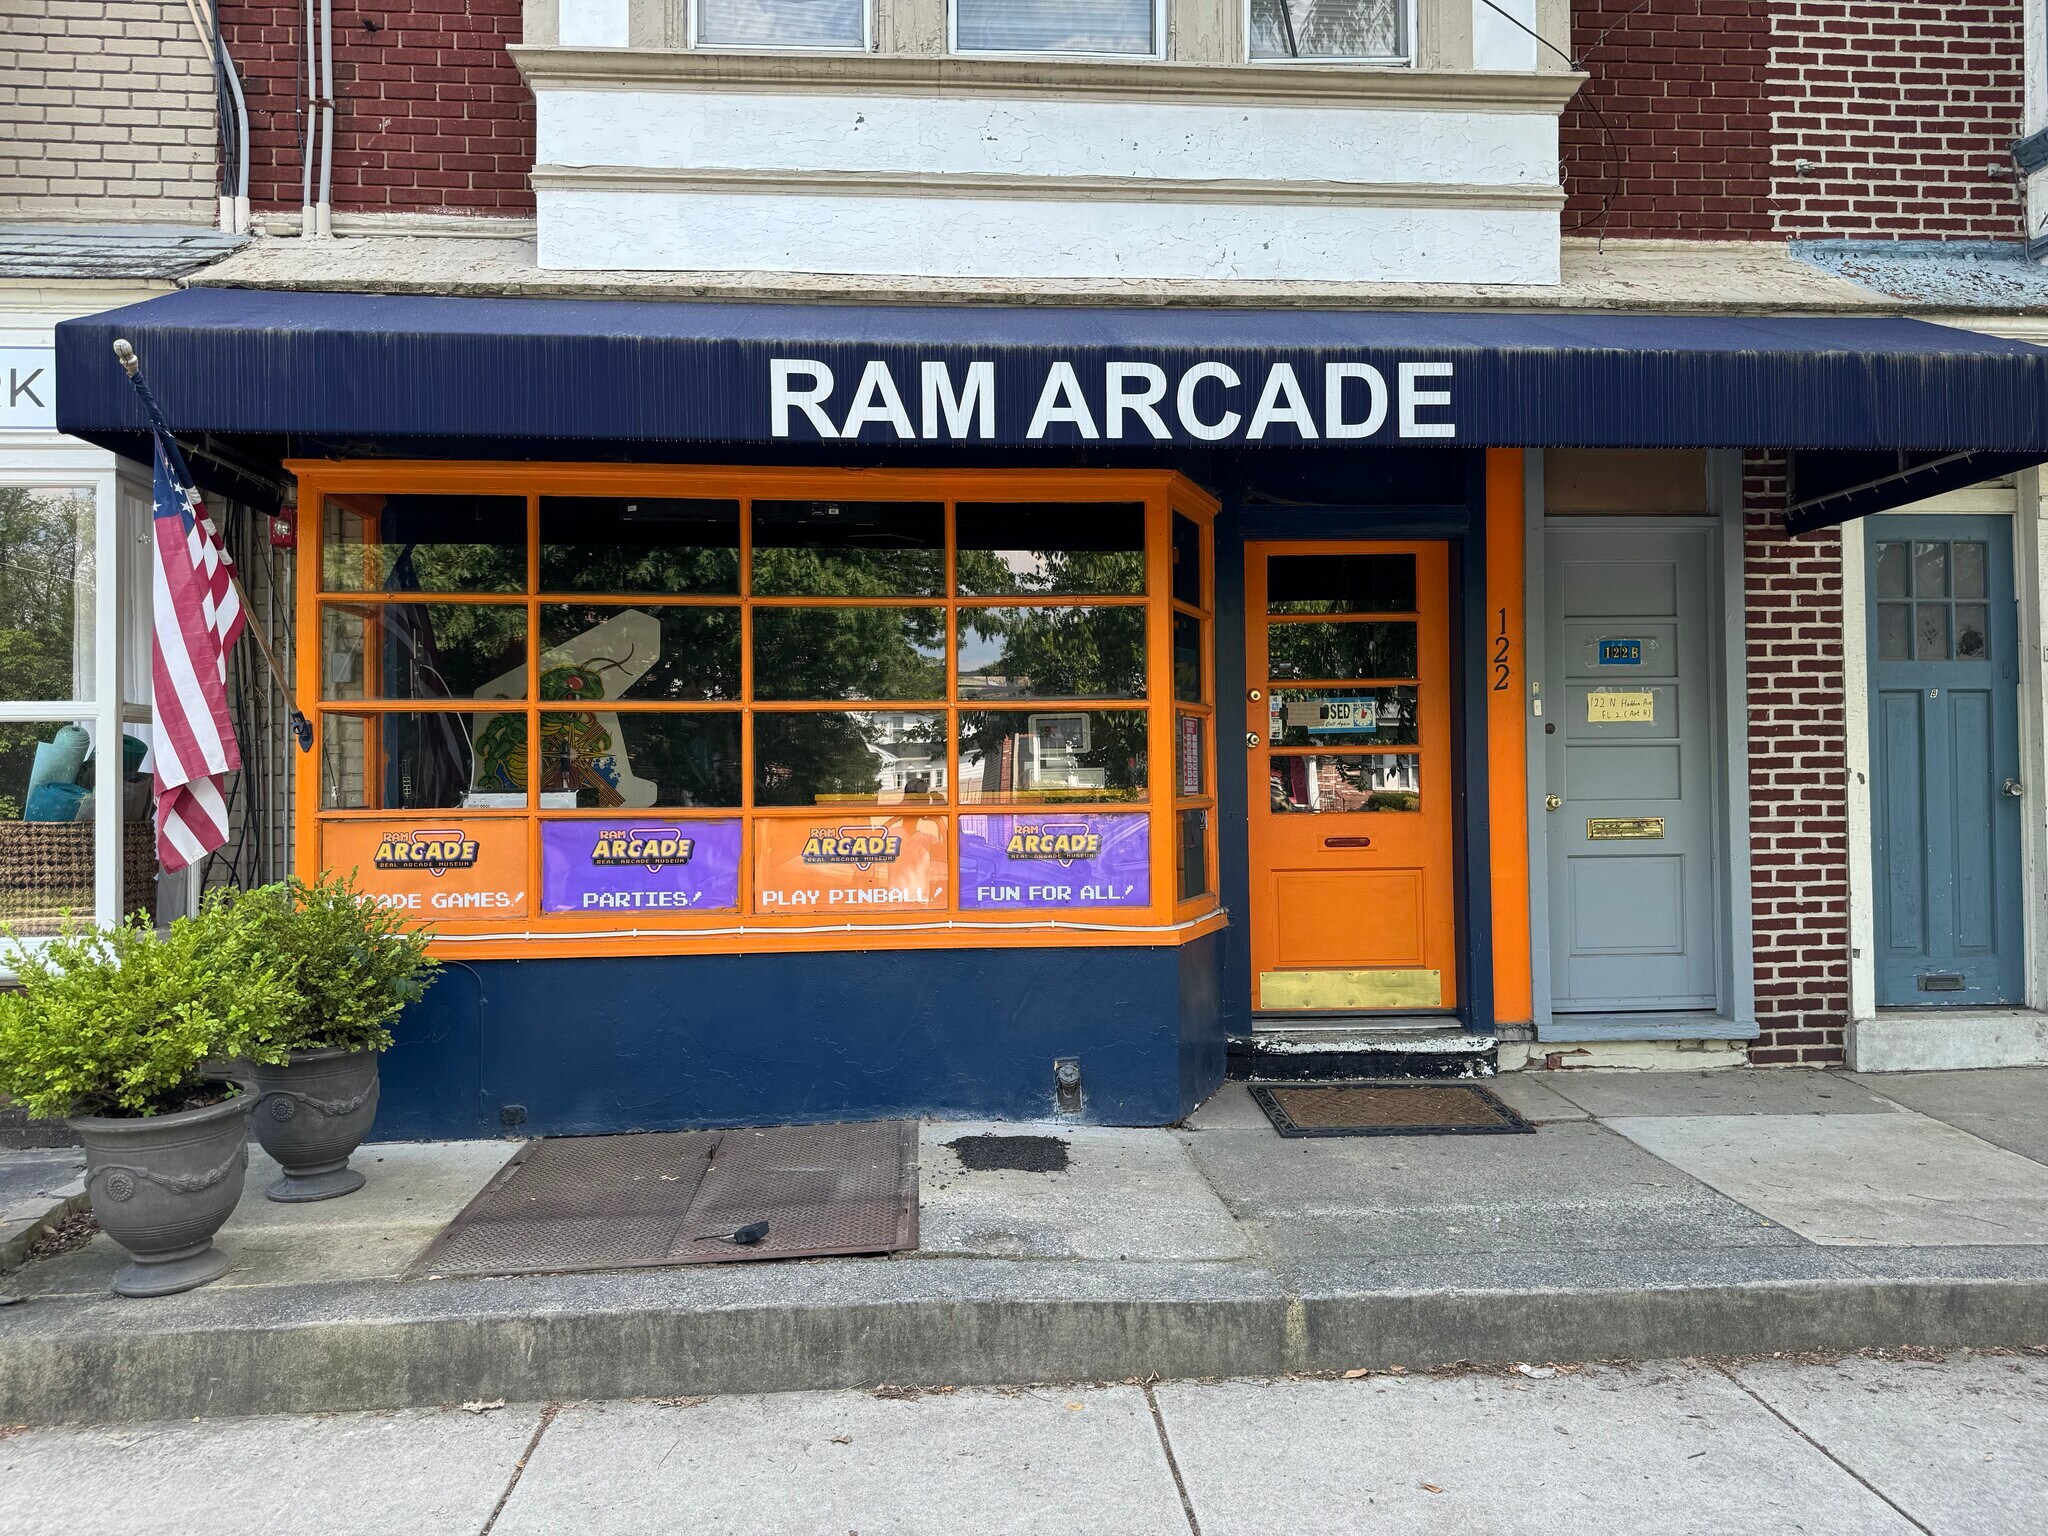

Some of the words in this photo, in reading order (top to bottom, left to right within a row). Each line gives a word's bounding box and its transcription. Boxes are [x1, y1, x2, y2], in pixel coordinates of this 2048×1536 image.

[0, 368, 45, 408] K
[770, 358, 995, 439] RAM
[1025, 361, 1456, 440] ARCADE
[1493, 608, 1510, 691] 122
[1591, 698, 1604, 707] 122
[1610, 698, 1616, 707] N
[383, 832, 409, 842] RAM
[599, 830, 626, 839] RAM
[810, 828, 836, 837] RAM
[1014, 825, 1038, 834] RAM
[375, 841, 478, 861] ARCADE
[592, 839, 693, 858] ARCADE
[803, 838, 899, 855] ARCADE
[1006, 835, 1099, 851] ARCADE
[431, 892, 525, 909] GAMES!
[583, 891, 702, 907] PARTIES!
[762, 890, 820, 905] PLAY
[829, 887, 943, 904] PINBALL!
[977, 886, 1020, 901] FUN
[1029, 885, 1071, 900] FOR
[1080, 884, 1133, 900] ALL!
